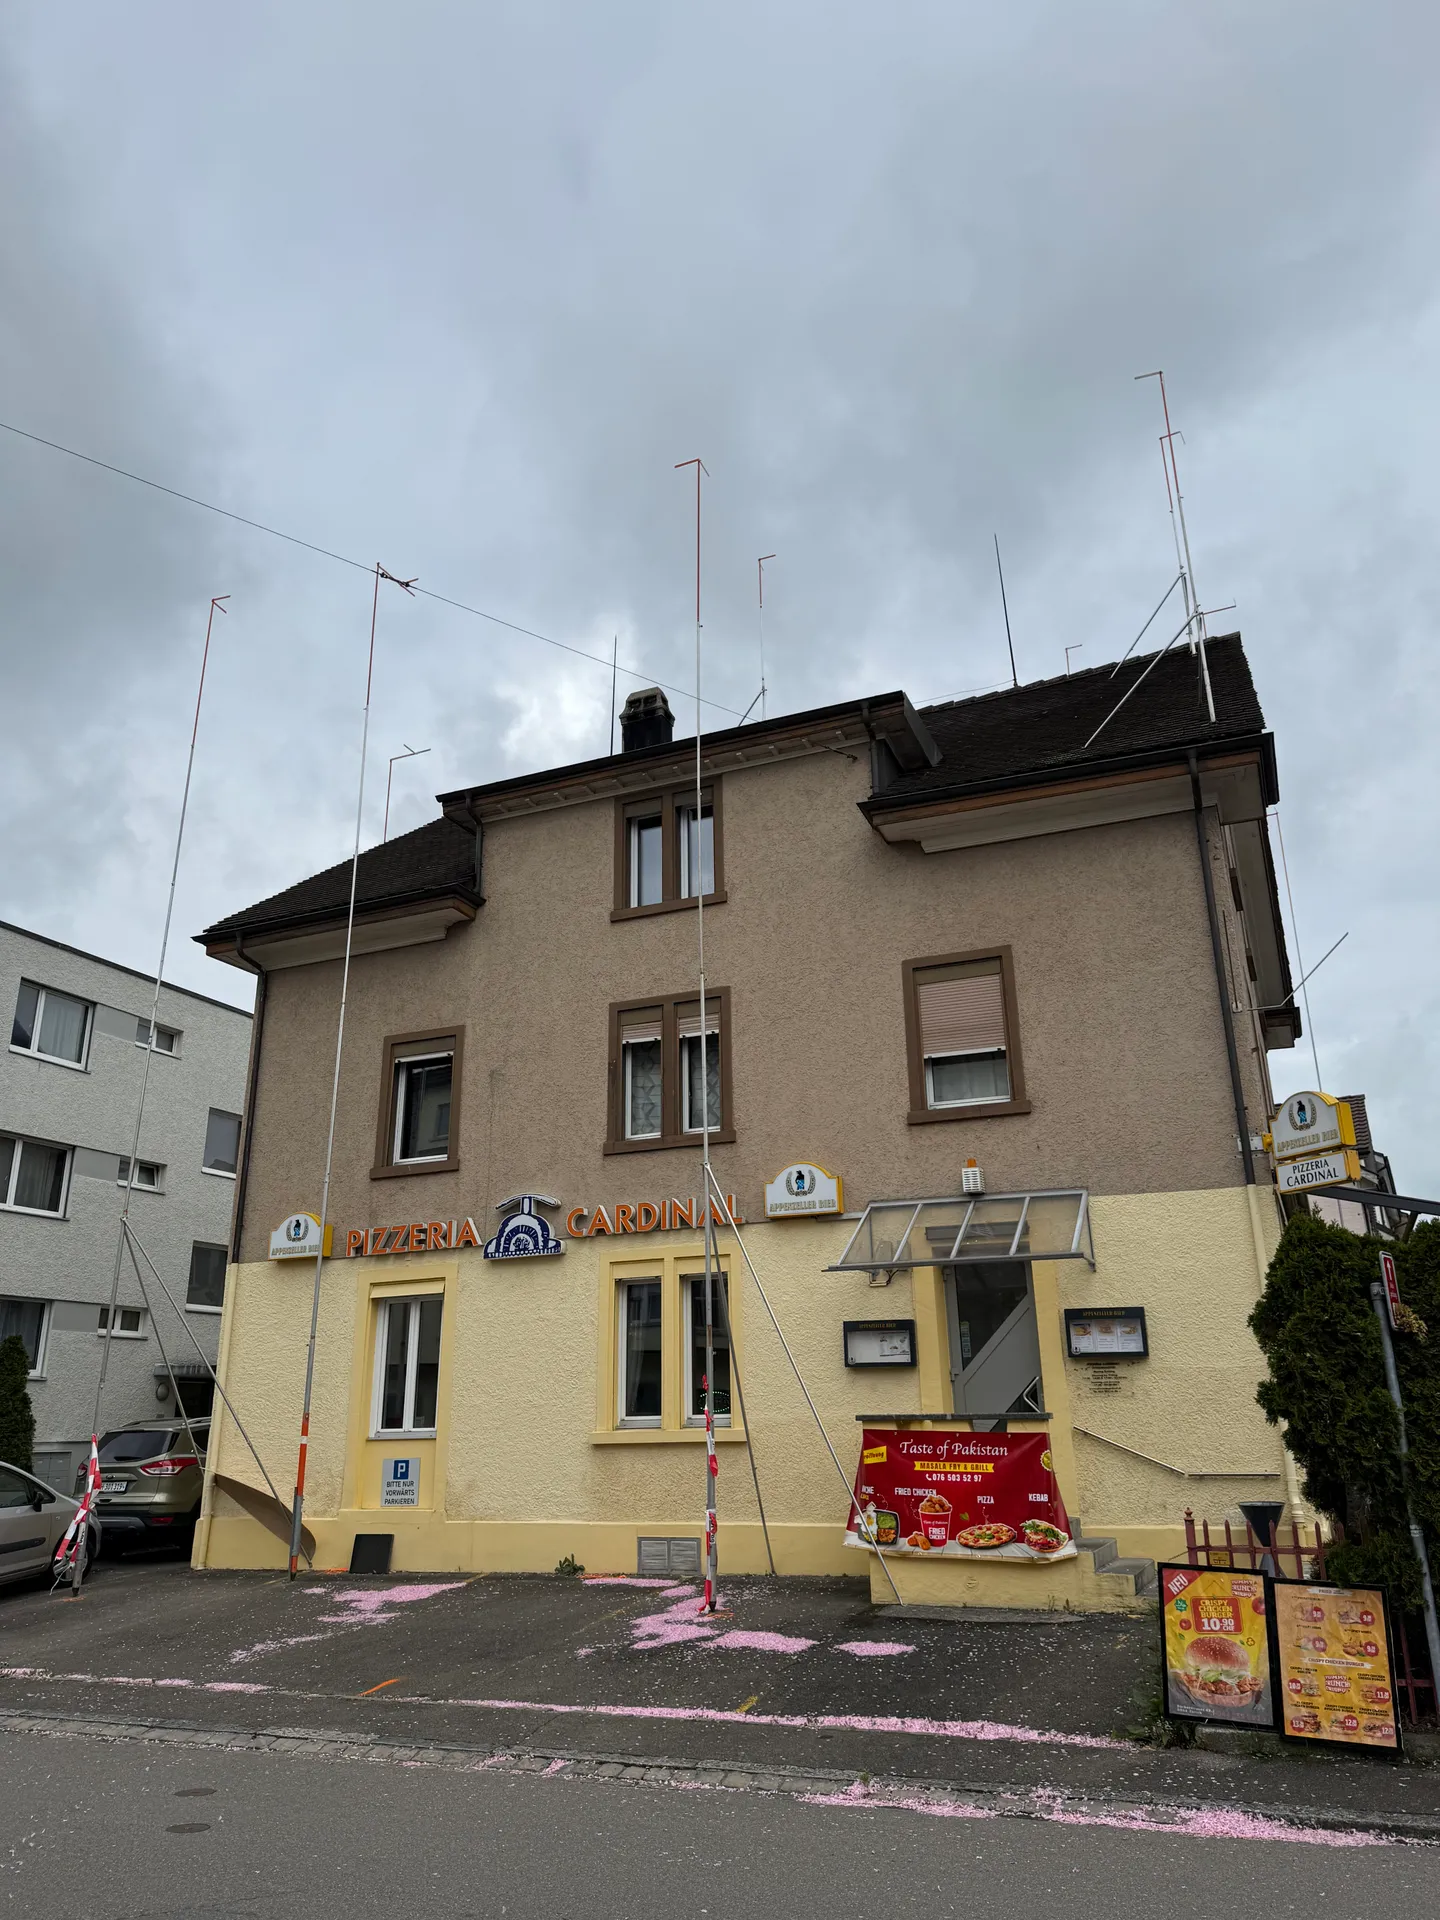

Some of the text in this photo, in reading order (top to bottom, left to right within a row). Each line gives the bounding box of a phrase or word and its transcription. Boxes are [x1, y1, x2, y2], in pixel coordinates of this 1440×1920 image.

[1292, 1159, 1329, 1174] PIZZERIA
[1287, 1168, 1339, 1187] CARDINAL
[770, 1199, 836, 1212] APPENZELLER BIER
[346, 1194, 744, 1257] PIZZERIA CARDINAL
[308, 1244, 320, 1253] BIE
[900, 1439, 1008, 1460] Taste of Pakistan
[920, 1462, 946, 1470] MASALA
[962, 1474, 971, 1482] 52
[385, 1488, 415, 1496] VORWÄRTS
[895, 1487, 937, 1496] FRIED CHICKEN
[977, 1496, 995, 1504] PIZZA
[1028, 1493, 1048, 1502] KEBAB
[1167, 1573, 1189, 1595] NEU
